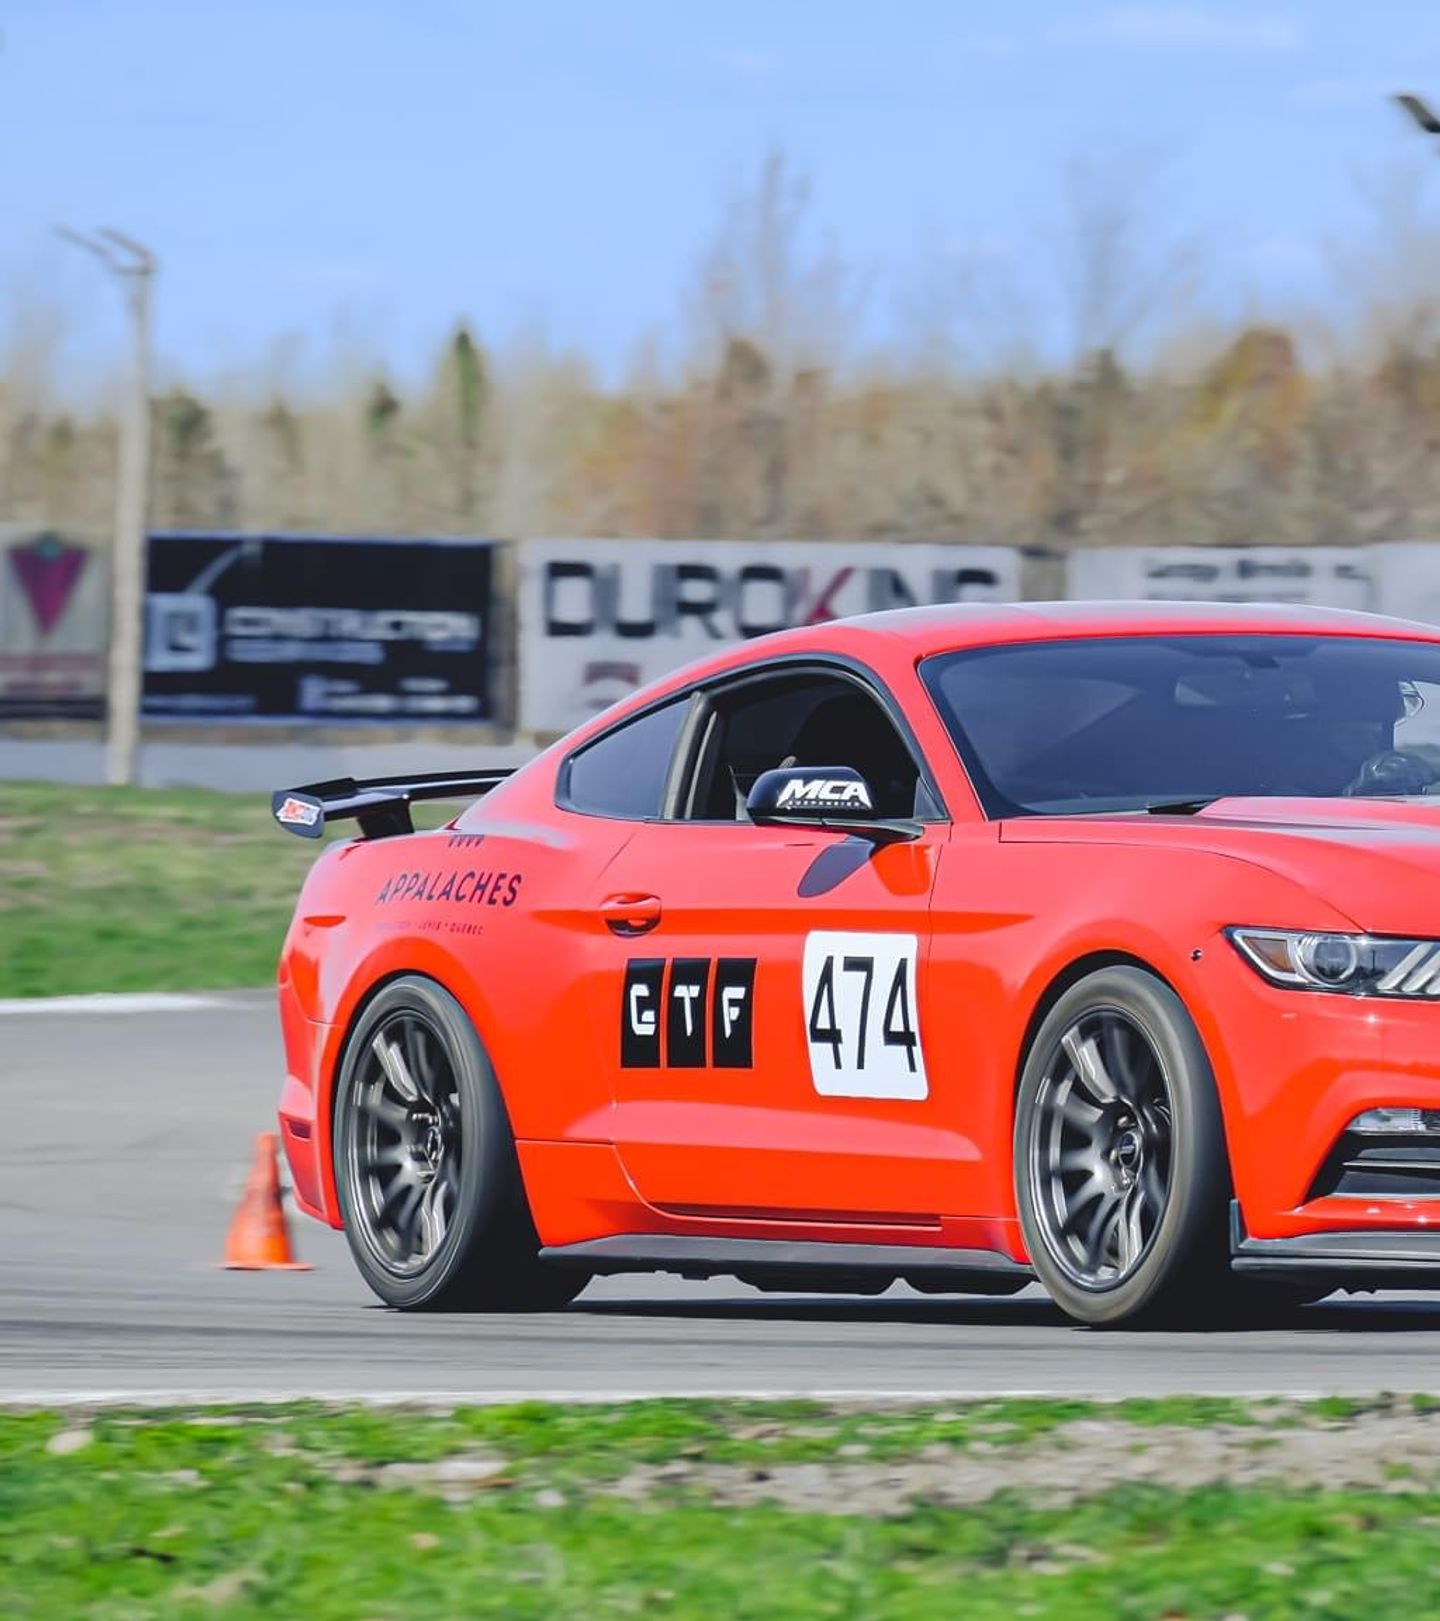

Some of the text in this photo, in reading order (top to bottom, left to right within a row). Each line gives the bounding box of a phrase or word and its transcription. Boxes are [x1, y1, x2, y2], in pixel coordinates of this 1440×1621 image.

[776, 779, 872, 809] MCA
[376, 869, 522, 906] APPALACHES
[630, 983, 746, 1039] GTF
[809, 954, 917, 1073] 474
